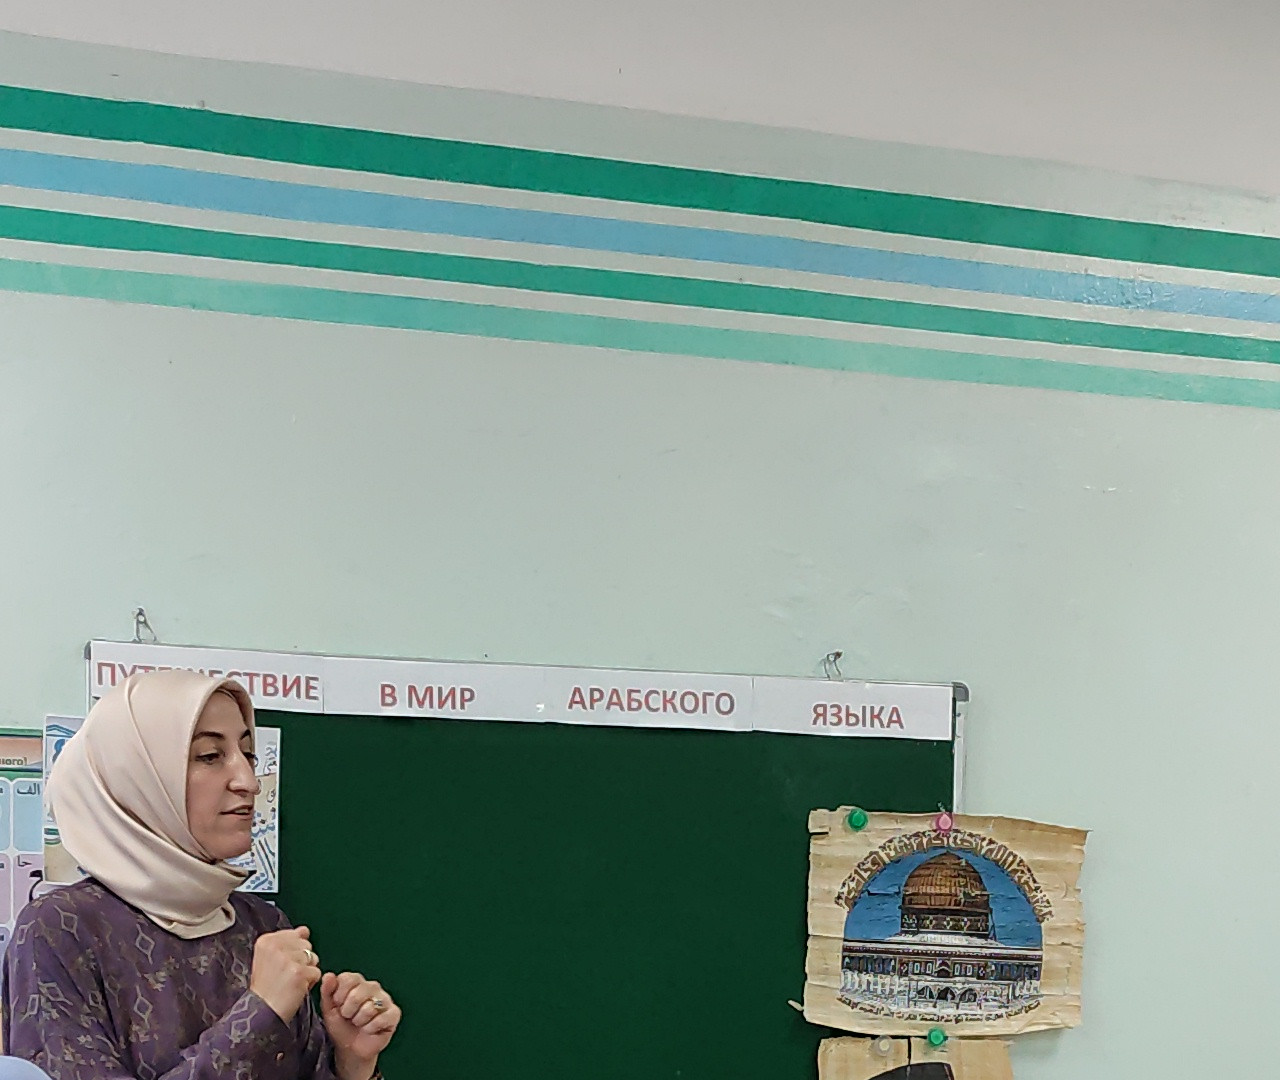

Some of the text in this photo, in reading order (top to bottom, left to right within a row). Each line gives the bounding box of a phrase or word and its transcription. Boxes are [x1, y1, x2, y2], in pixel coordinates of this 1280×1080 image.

[380, 683, 397, 708] В
[407, 684, 476, 712] МИР
[568, 687, 736, 716] АРАБСКОГО
[812, 703, 905, 730] ЯЗЫКА
